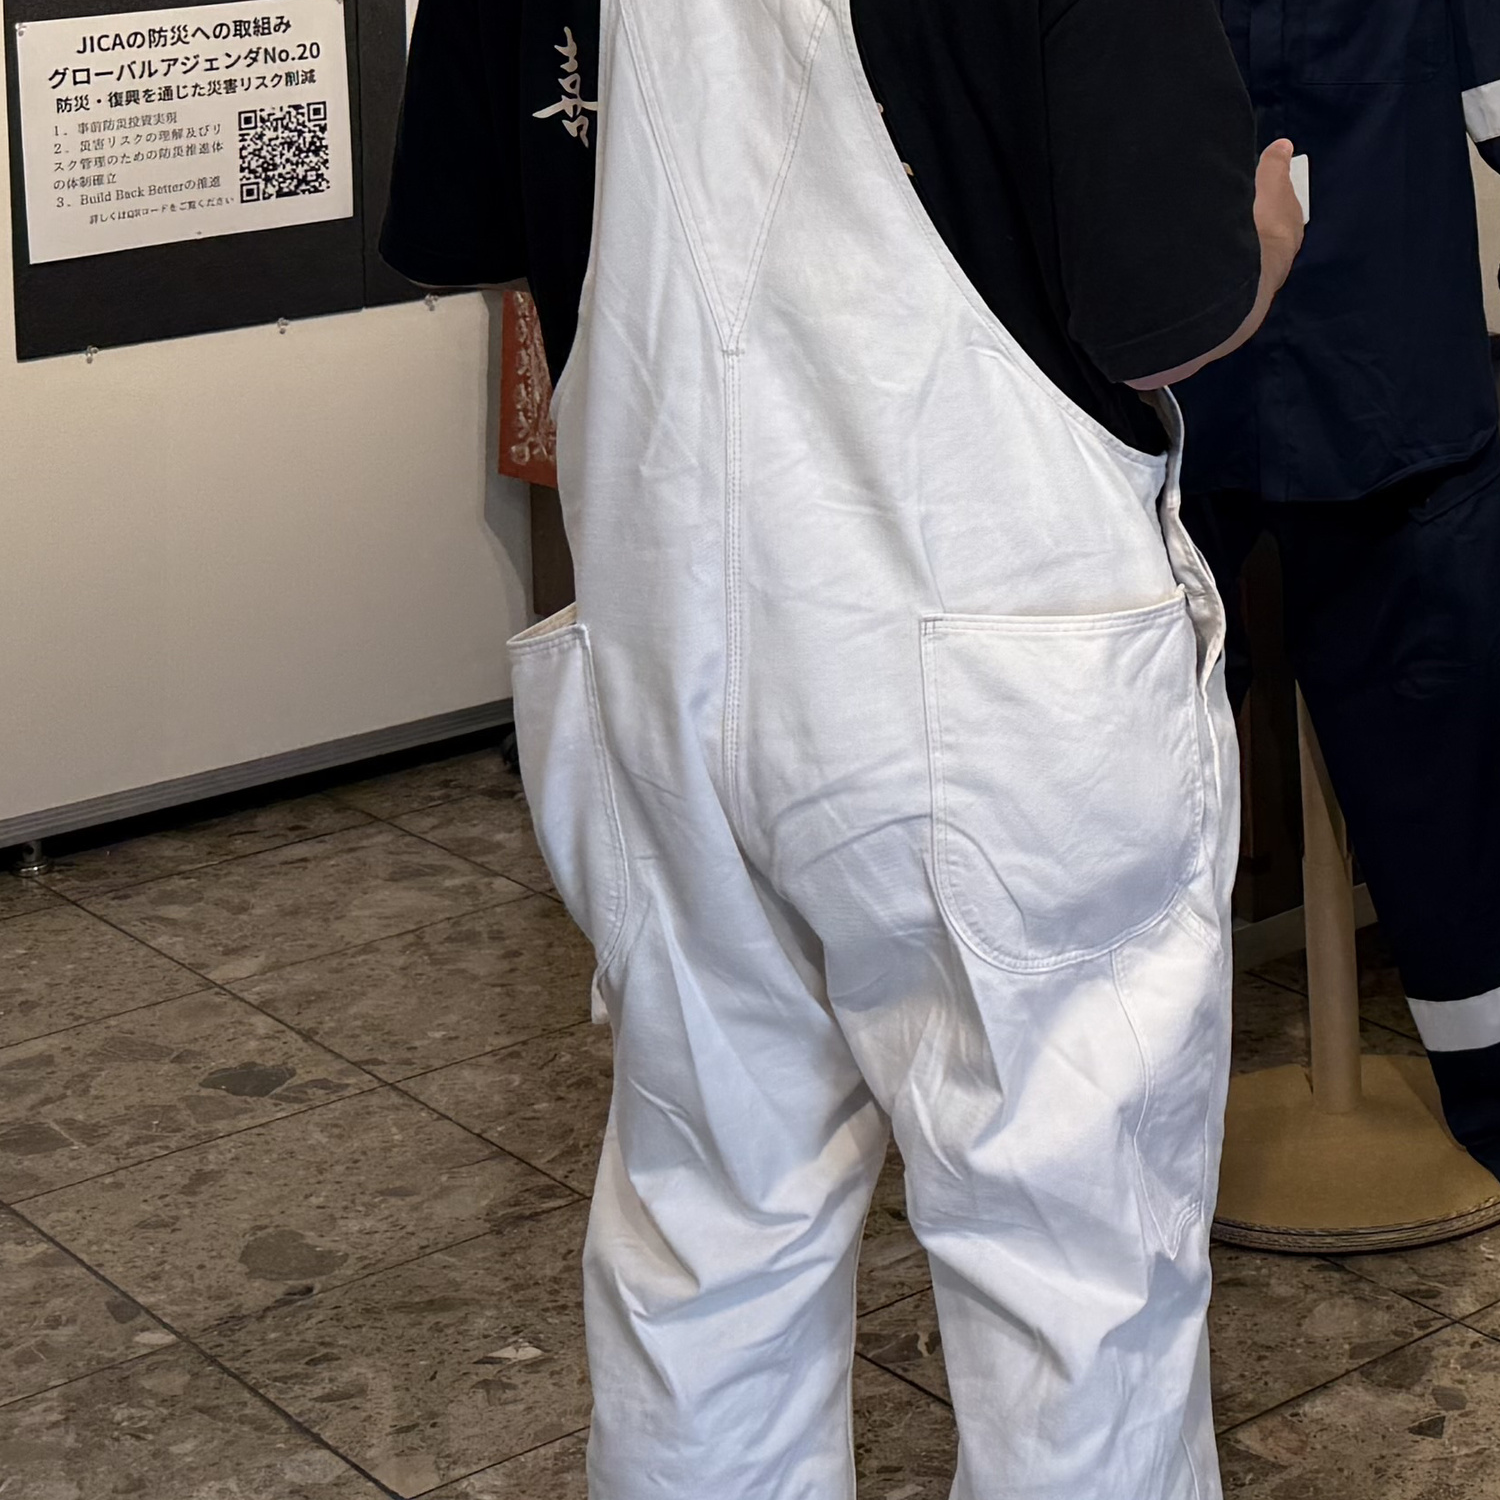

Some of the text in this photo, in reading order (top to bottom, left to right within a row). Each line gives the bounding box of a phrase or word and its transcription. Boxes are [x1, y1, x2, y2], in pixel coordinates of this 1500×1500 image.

[76, 15, 292, 54] JICAの防災への取組み
